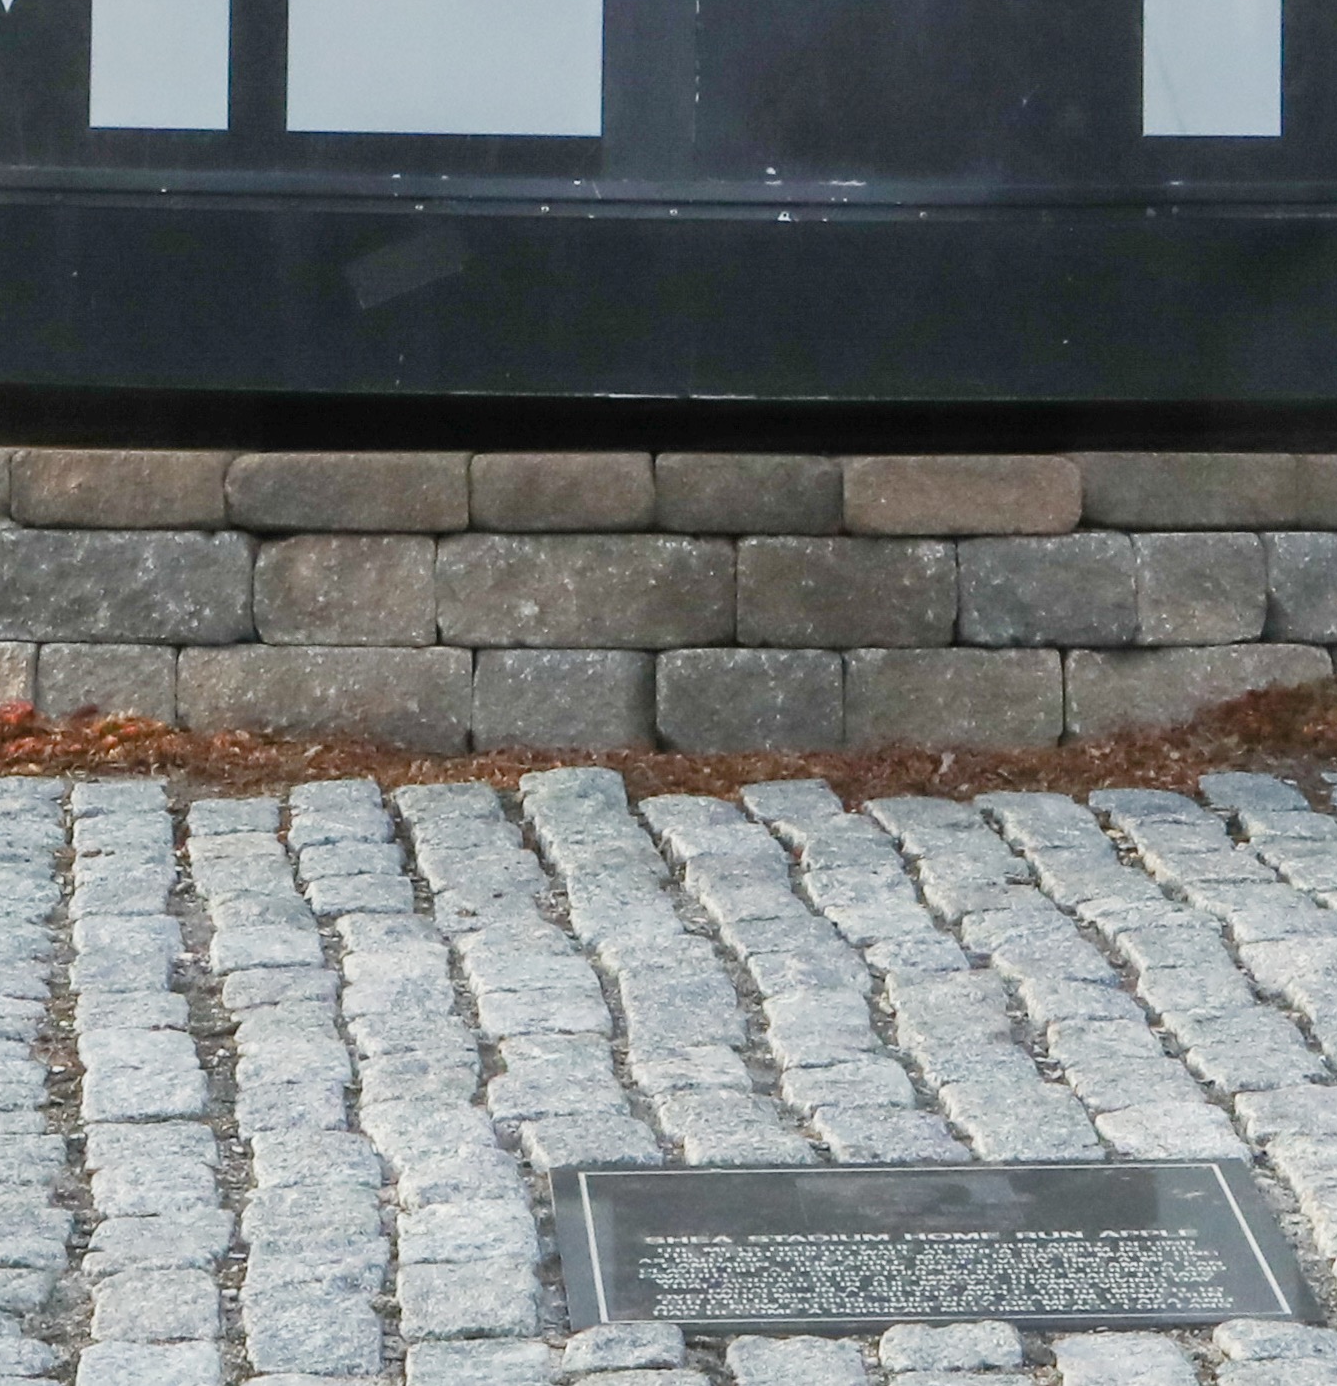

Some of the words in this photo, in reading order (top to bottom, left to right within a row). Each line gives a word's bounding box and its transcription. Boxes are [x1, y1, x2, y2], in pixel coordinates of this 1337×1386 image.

[645, 1236, 732, 1245] SHEA
[748, 1233, 890, 1243] STADIUM
[904, 1231, 1000, 1241] HOME
[1015, 1230, 1084, 1239] RUN
[1099, 1229, 1199, 1238] APPLE
